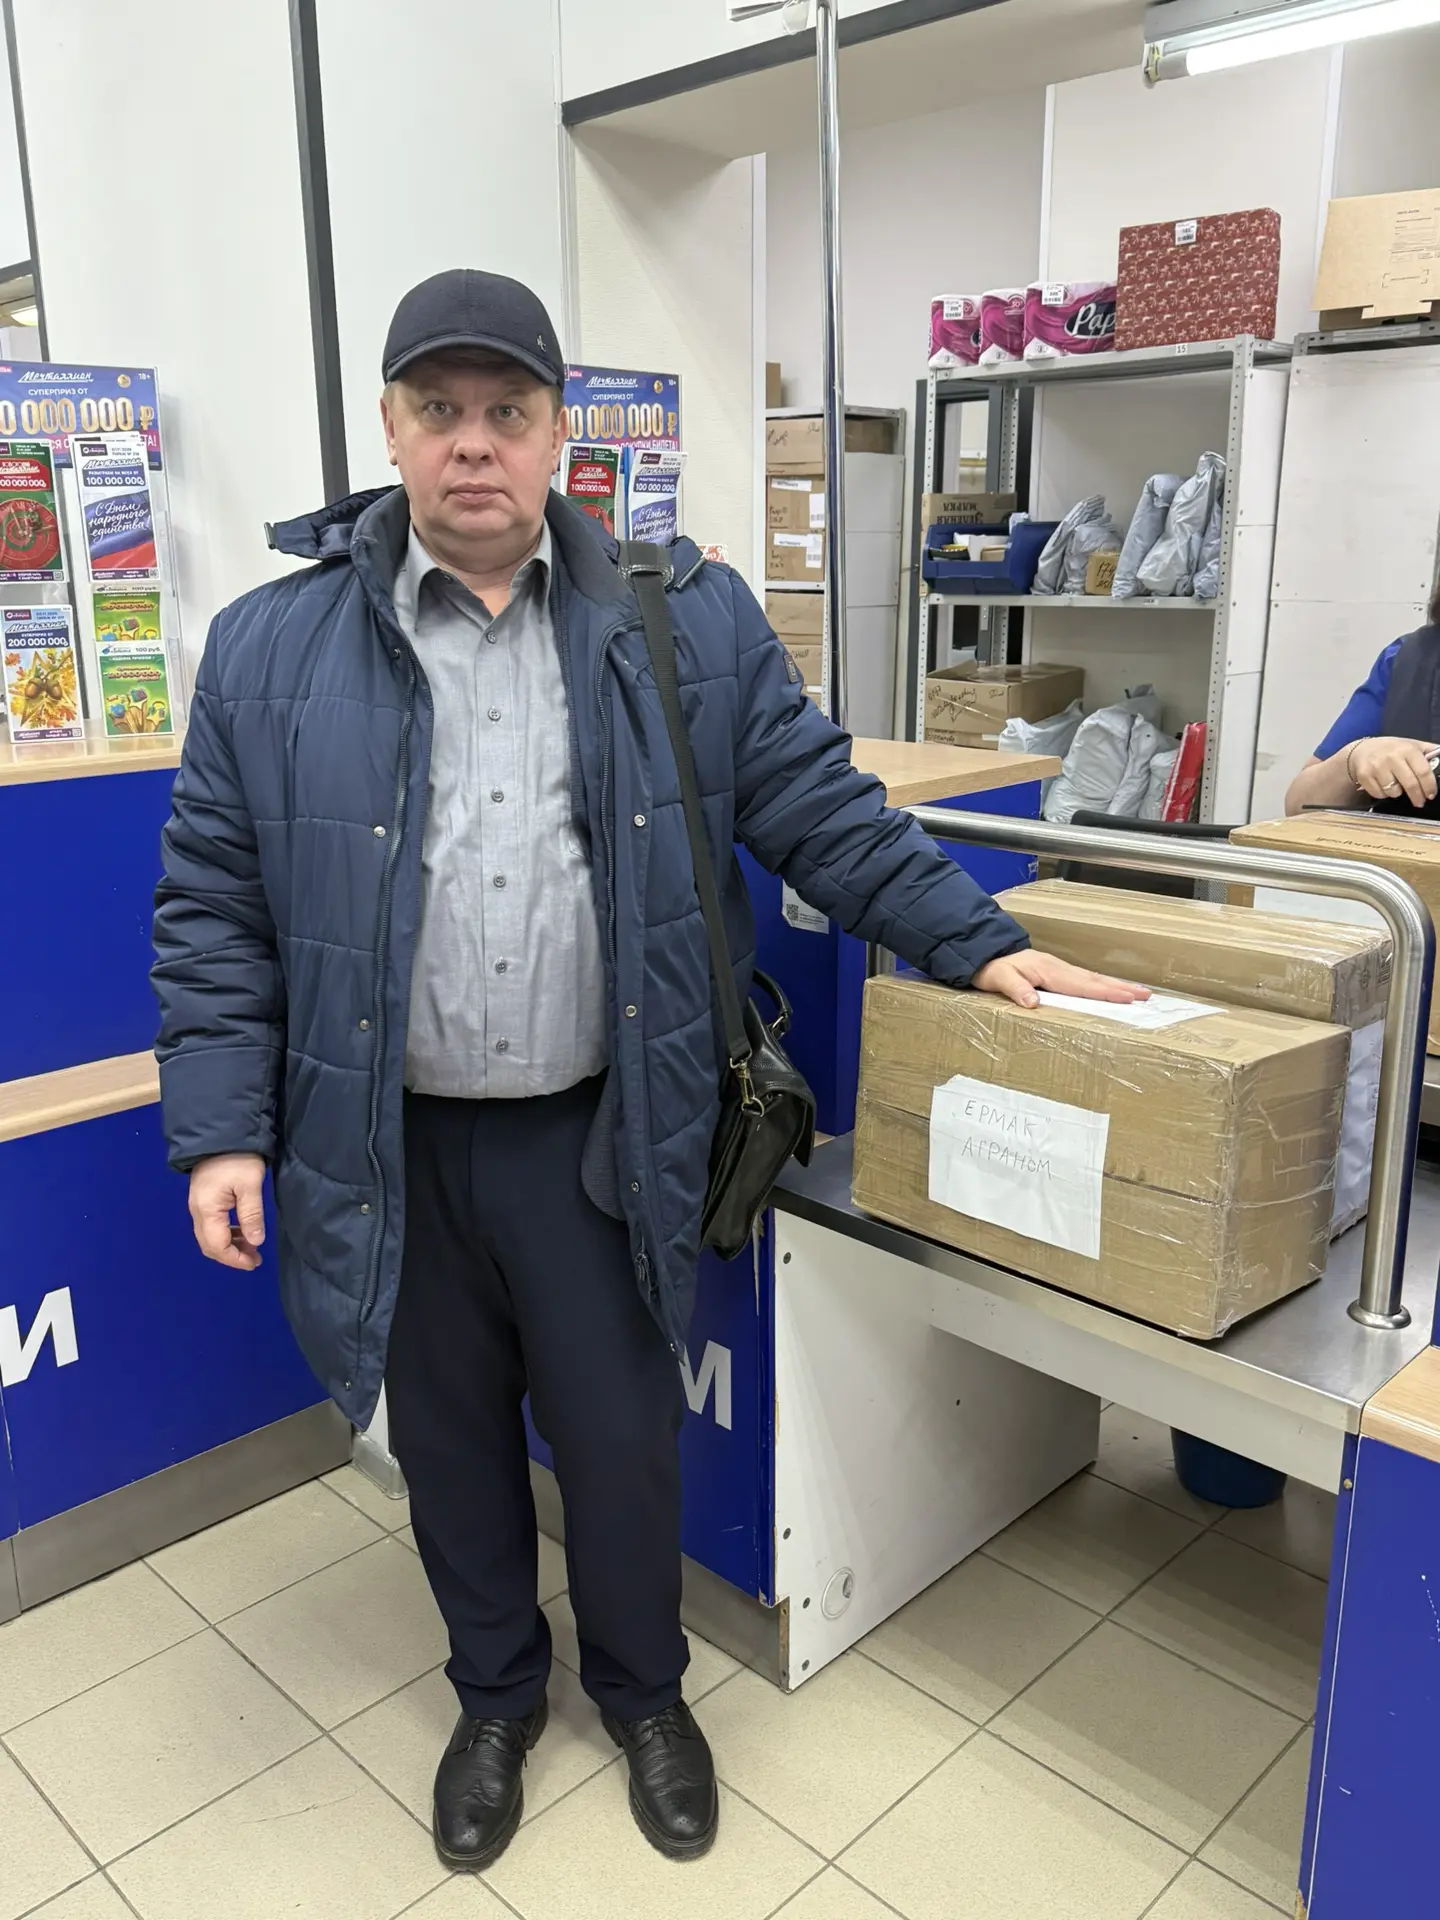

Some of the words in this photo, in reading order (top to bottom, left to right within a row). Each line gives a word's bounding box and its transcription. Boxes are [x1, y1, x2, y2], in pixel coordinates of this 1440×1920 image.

[18, 371, 94, 383] Мечталлион
[28, 388, 76, 396] СУПЕРПРИЗ
[77, 387, 88, 396] ОТ
[20, 398, 77, 435] 000
[79, 397, 134, 433] 000
[587, 403, 625, 440] 000
[627, 403, 663, 438] 000
[86, 477, 103, 485] 100
[104, 477, 123, 485] 000
[8, 638, 26, 647] 200
[27, 638, 47, 646] 000
